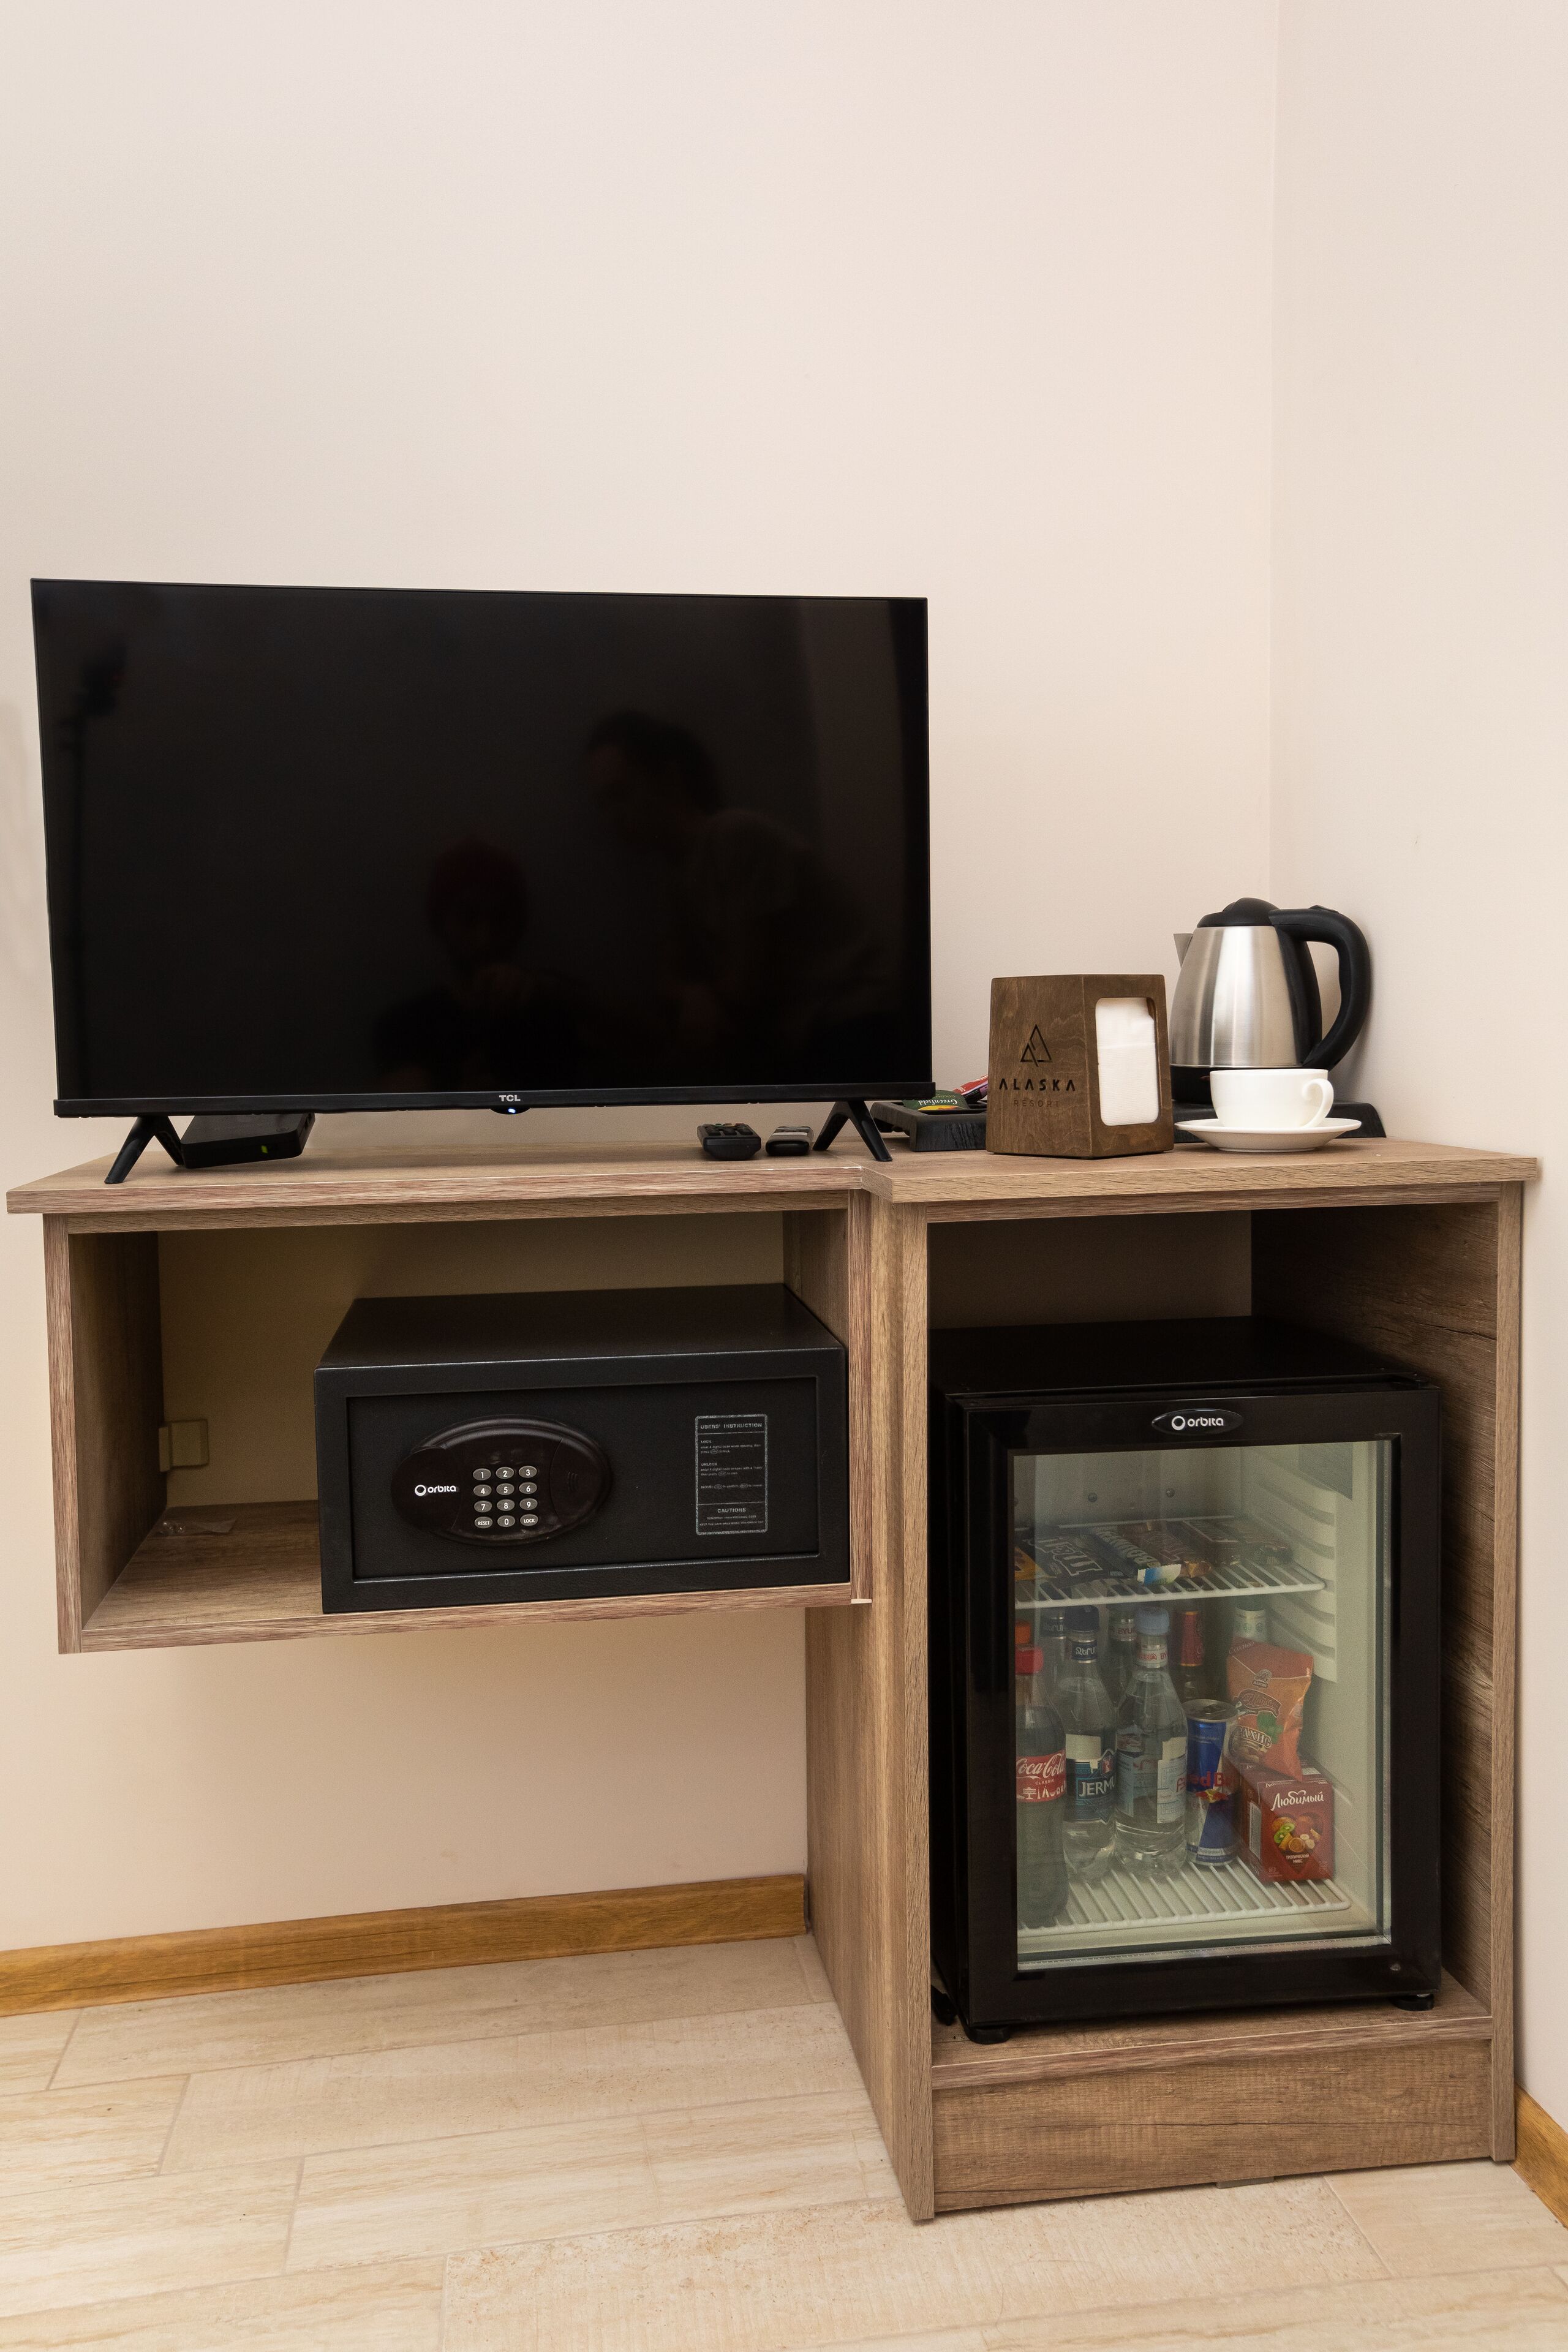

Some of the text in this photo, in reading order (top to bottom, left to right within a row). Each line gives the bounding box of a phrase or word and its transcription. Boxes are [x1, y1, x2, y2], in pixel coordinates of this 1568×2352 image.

[998, 1078, 1076, 1091] ALASKA
[1187, 1417, 1224, 1427] orbita
[1079, 1776, 1116, 1797] JERMU
[1270, 1790, 1324, 1811] Любимый
